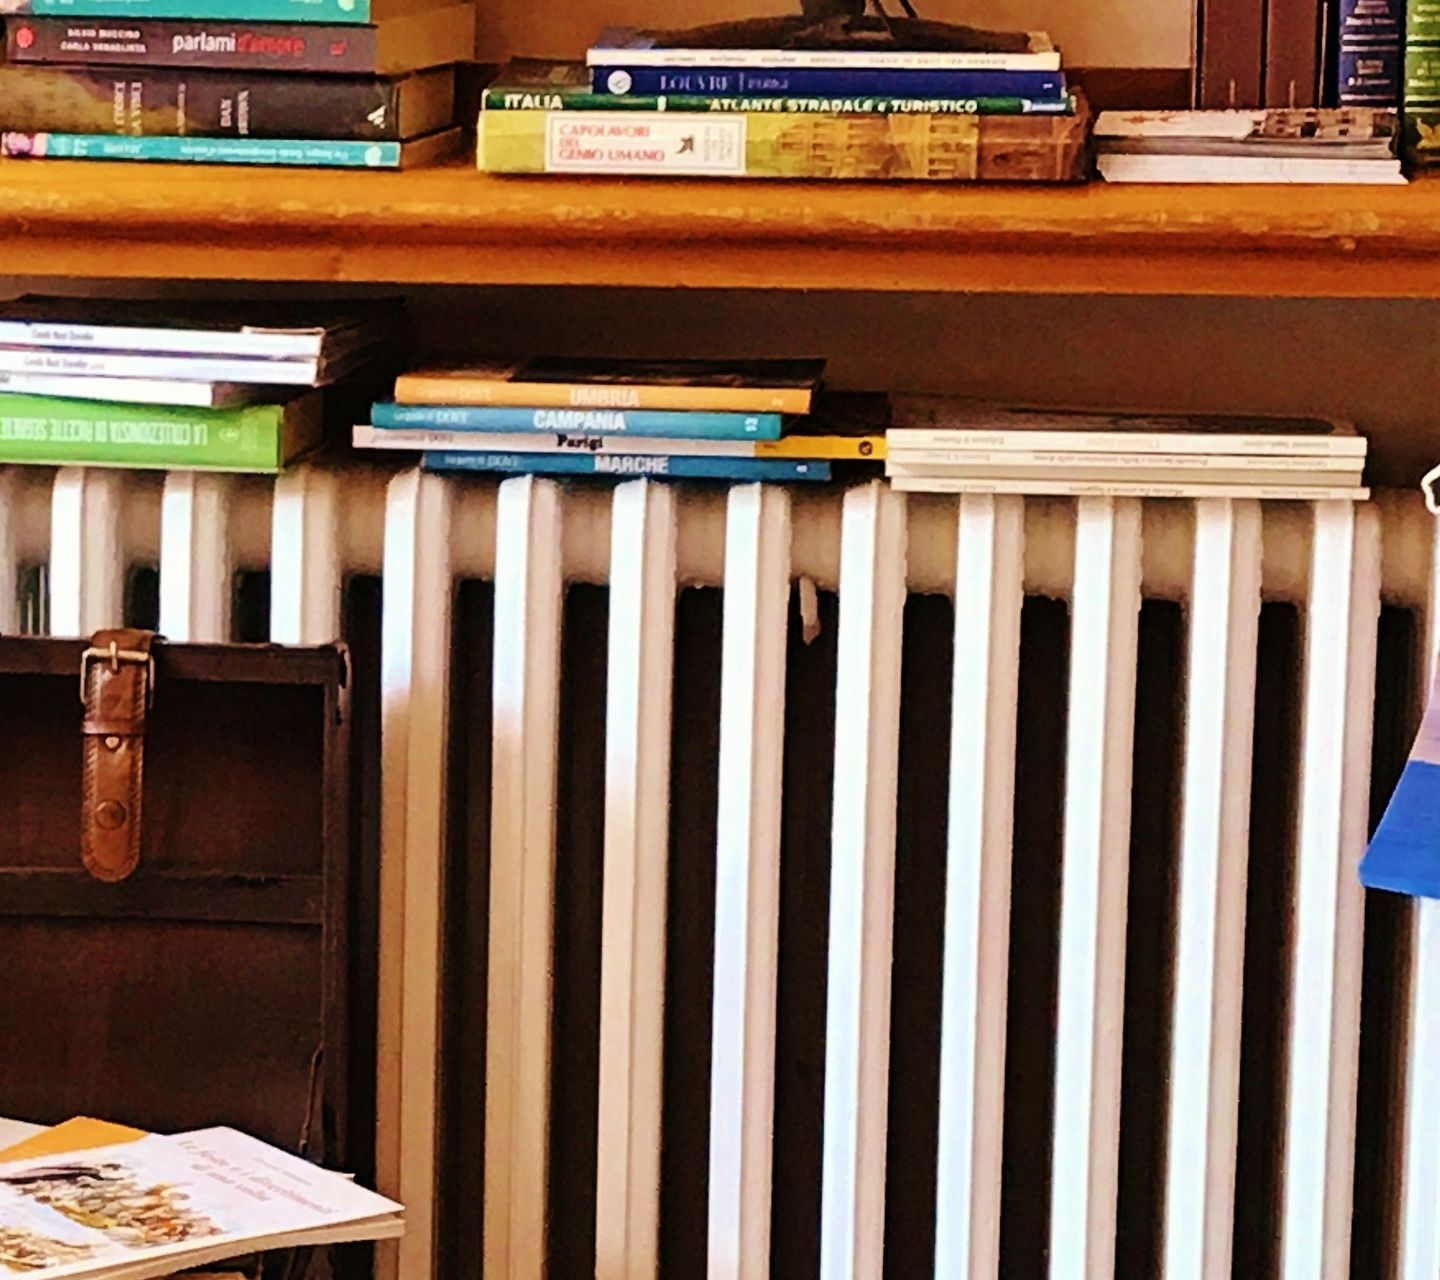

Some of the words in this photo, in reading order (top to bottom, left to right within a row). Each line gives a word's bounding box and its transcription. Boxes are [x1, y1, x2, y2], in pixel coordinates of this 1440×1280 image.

[172, 32, 236, 54] parlami
[237, 33, 305, 57] d'amore
[660, 74, 729, 92] LOUVRE
[504, 93, 563, 110] ITALIA
[891, 99, 978, 114] TURISTICO
[559, 124, 651, 138] CAPOLAVORI
[559, 148, 604, 161] GENIO
[608, 149, 666, 162] UMANO
[570, 388, 641, 408] UMBRIA
[532, 409, 627, 431] CAMPANIA
[556, 432, 603, 451] Parigi
[594, 454, 669, 474] MARCHE
